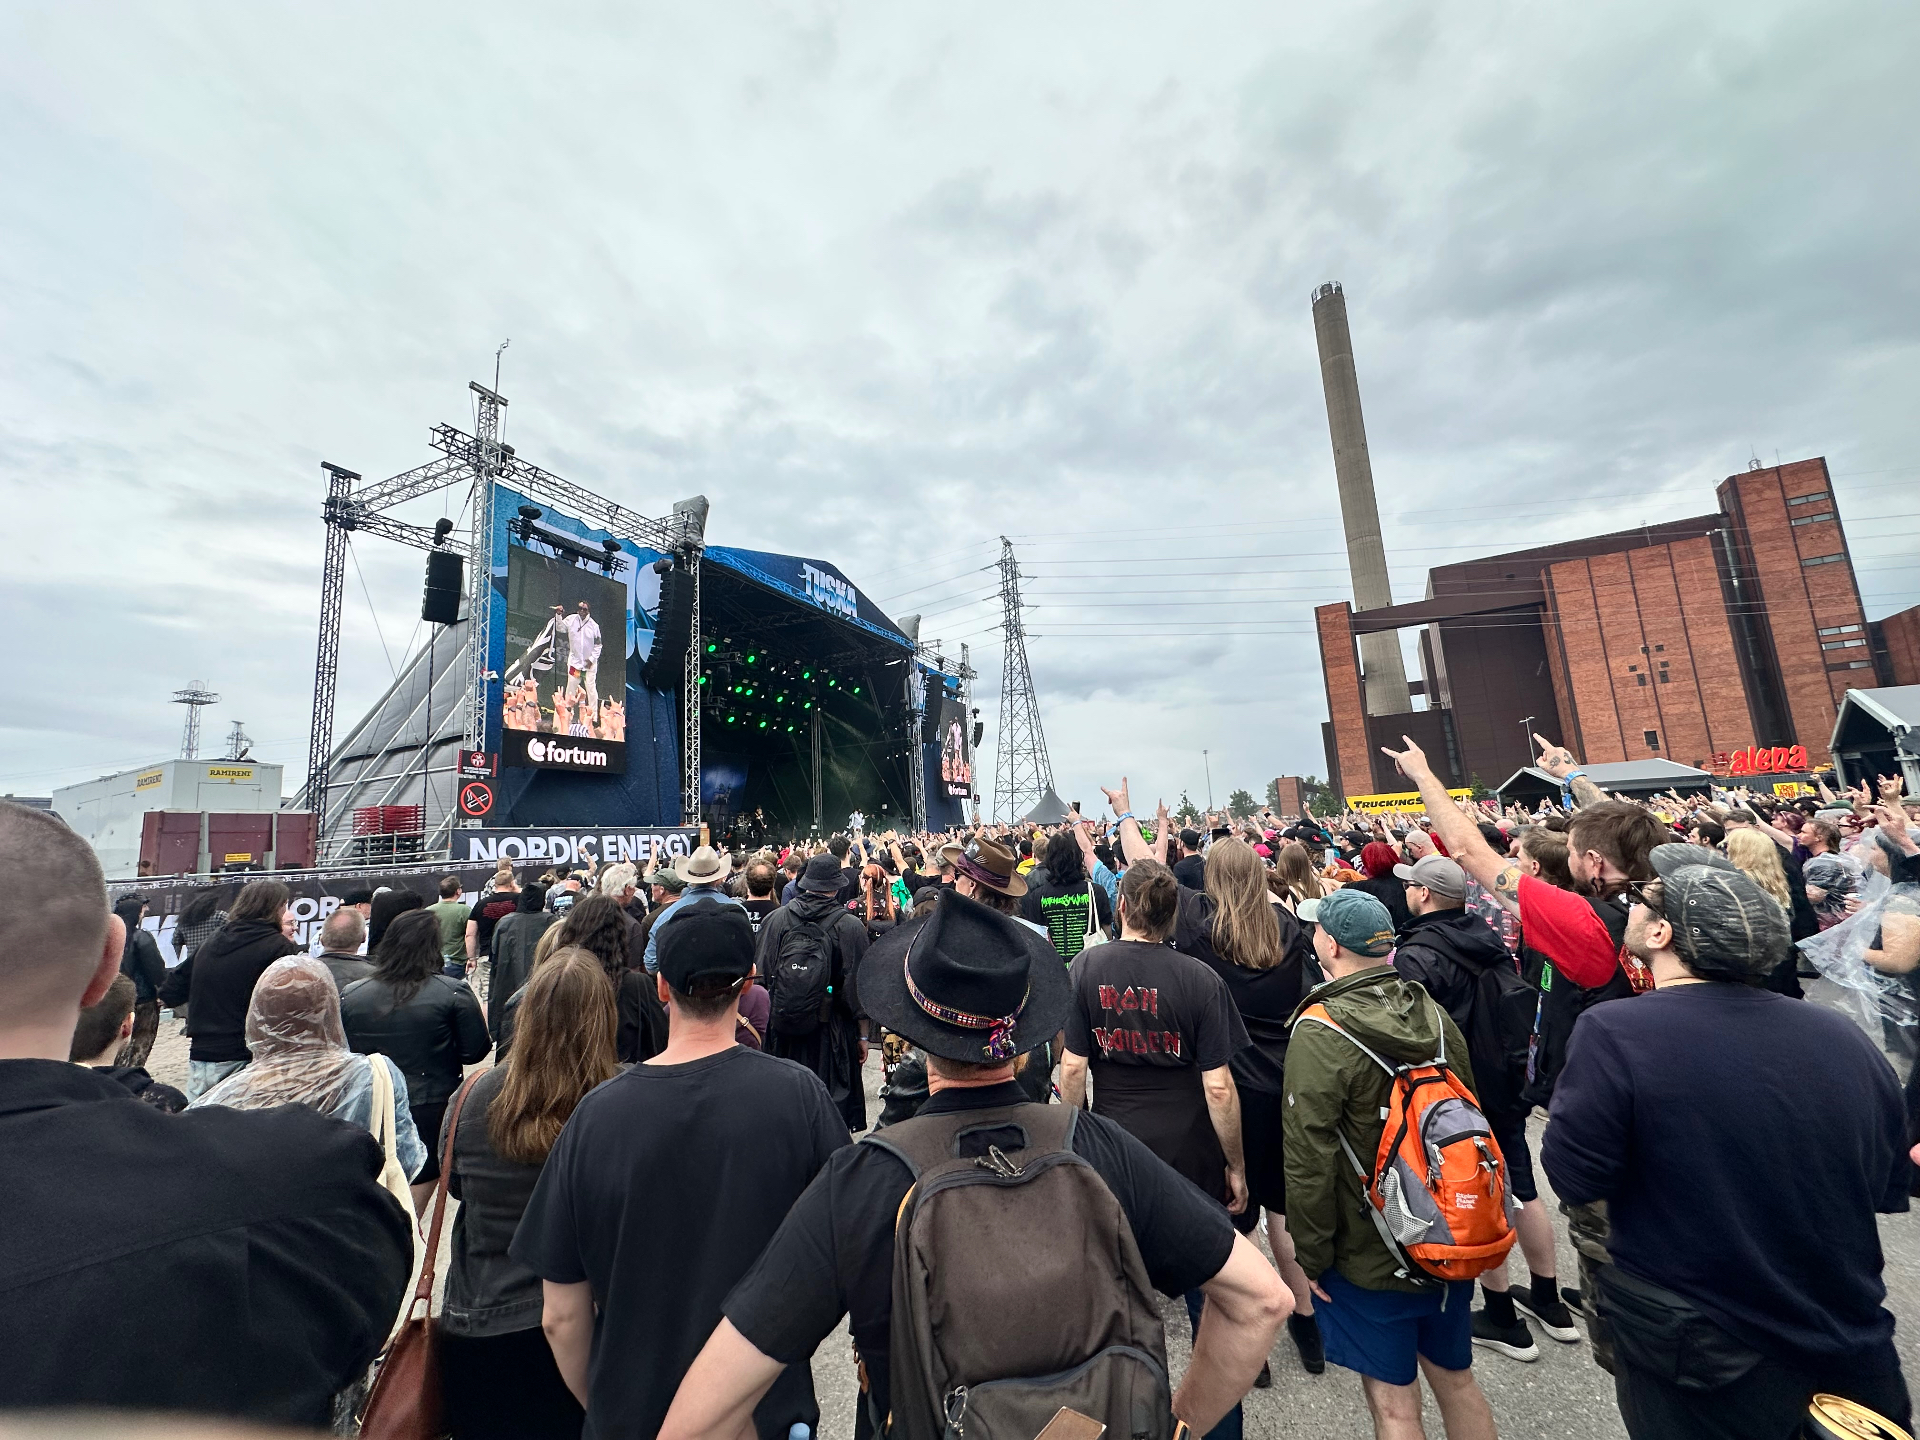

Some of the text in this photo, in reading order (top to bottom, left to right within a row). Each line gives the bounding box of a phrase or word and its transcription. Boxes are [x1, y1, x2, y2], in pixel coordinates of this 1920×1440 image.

[801, 562, 858, 619] TUSKA
[546, 740, 608, 767] fortum
[1729, 744, 1808, 773] alepa
[136, 773, 163, 788] RAMIRENT
[209, 769, 253, 778] RAMIRENT
[468, 832, 693, 865] NORDIC ENERGY
[1098, 984, 1159, 1019] IRON
[1091, 1026, 1181, 1058] MAIDEN
